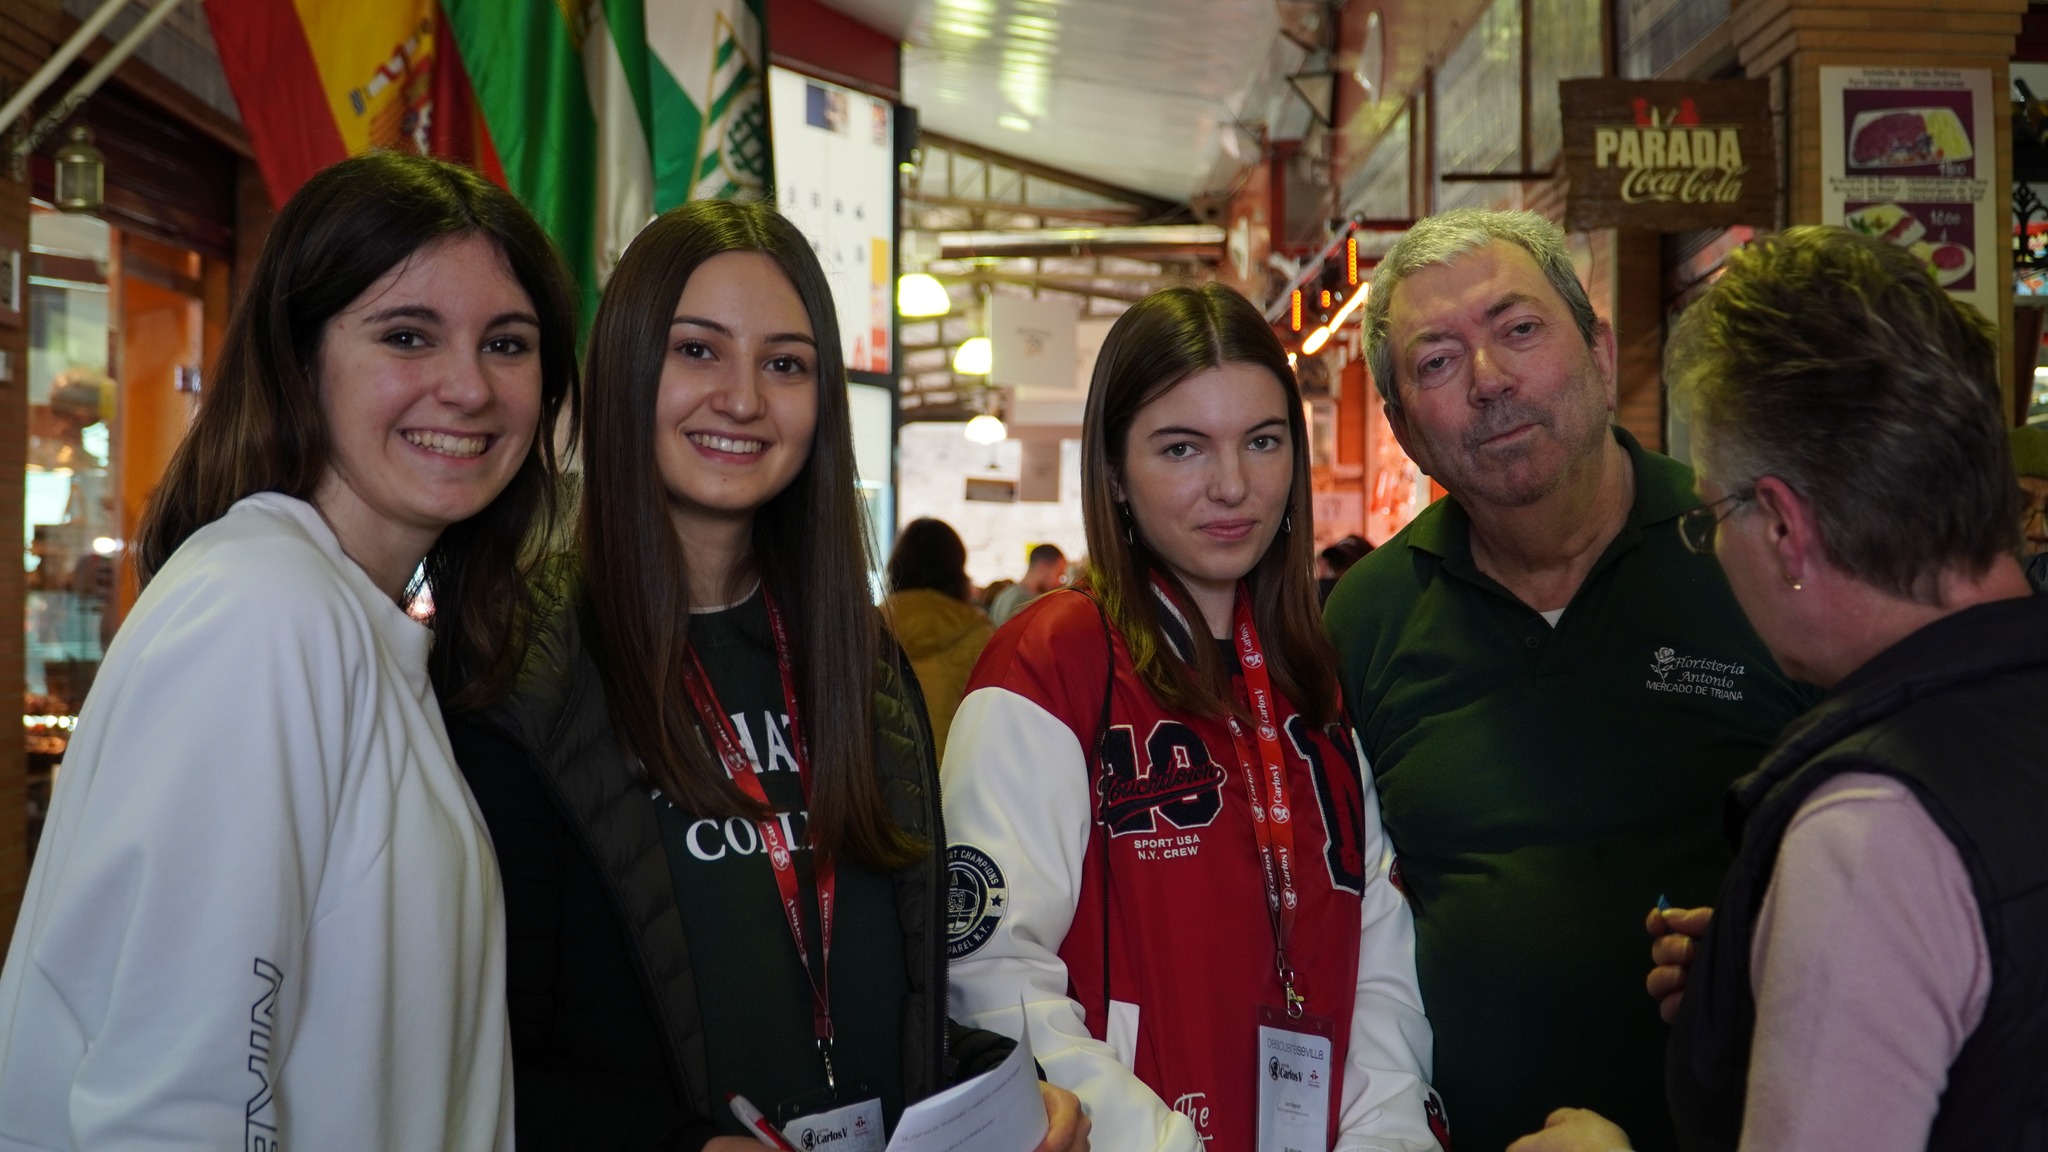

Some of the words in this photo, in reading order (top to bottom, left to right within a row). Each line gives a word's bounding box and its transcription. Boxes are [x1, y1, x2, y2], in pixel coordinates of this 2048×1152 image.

[1595, 127, 1743, 169] PARADA
[1646, 680, 1693, 694] MERCADO
[1695, 685, 1709, 695] DE
[1710, 687, 1744, 701] TRIANA
[1677, 672, 1734, 688] Antonio
[1257, 693, 1270, 724] Carlos
[1271, 772, 1283, 804] Carlos
[1134, 838, 1173, 850] SPORT
[1176, 833, 1201, 846] USA
[1138, 850, 1161, 861] N.Y.
[1163, 845, 1199, 859] CREW
[960, 849, 1000, 885] CHAMPIONS
[1265, 854, 1275, 890] Carlos
[1281, 854, 1292, 888] Carlos
[1280, 1067, 1298, 1082] Carlos
[1173, 1092, 1210, 1128] The
[816, 1130, 842, 1145] Carlos
